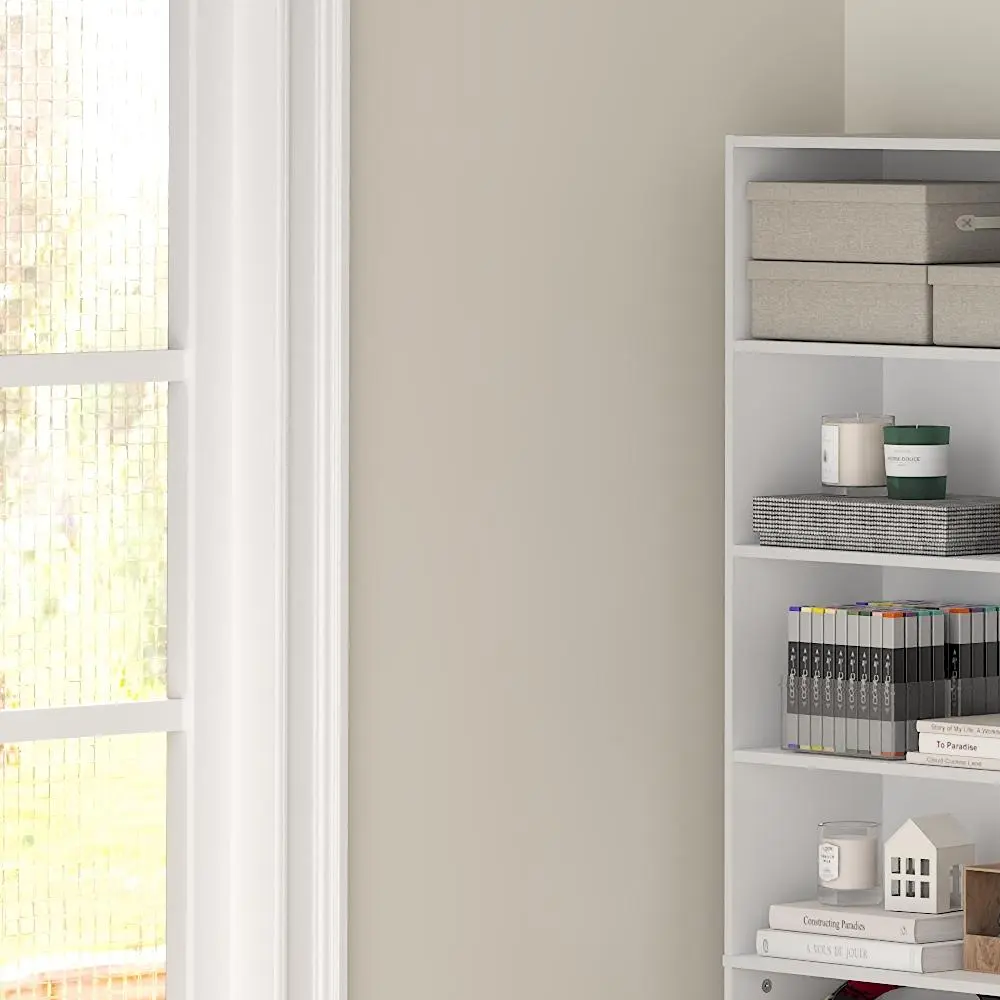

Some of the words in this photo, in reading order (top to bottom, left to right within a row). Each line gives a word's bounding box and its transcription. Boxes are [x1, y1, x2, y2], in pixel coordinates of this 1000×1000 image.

[936, 740, 946, 749] To
[946, 741, 978, 752] Paradise
[803, 915, 840, 930] Constructing
